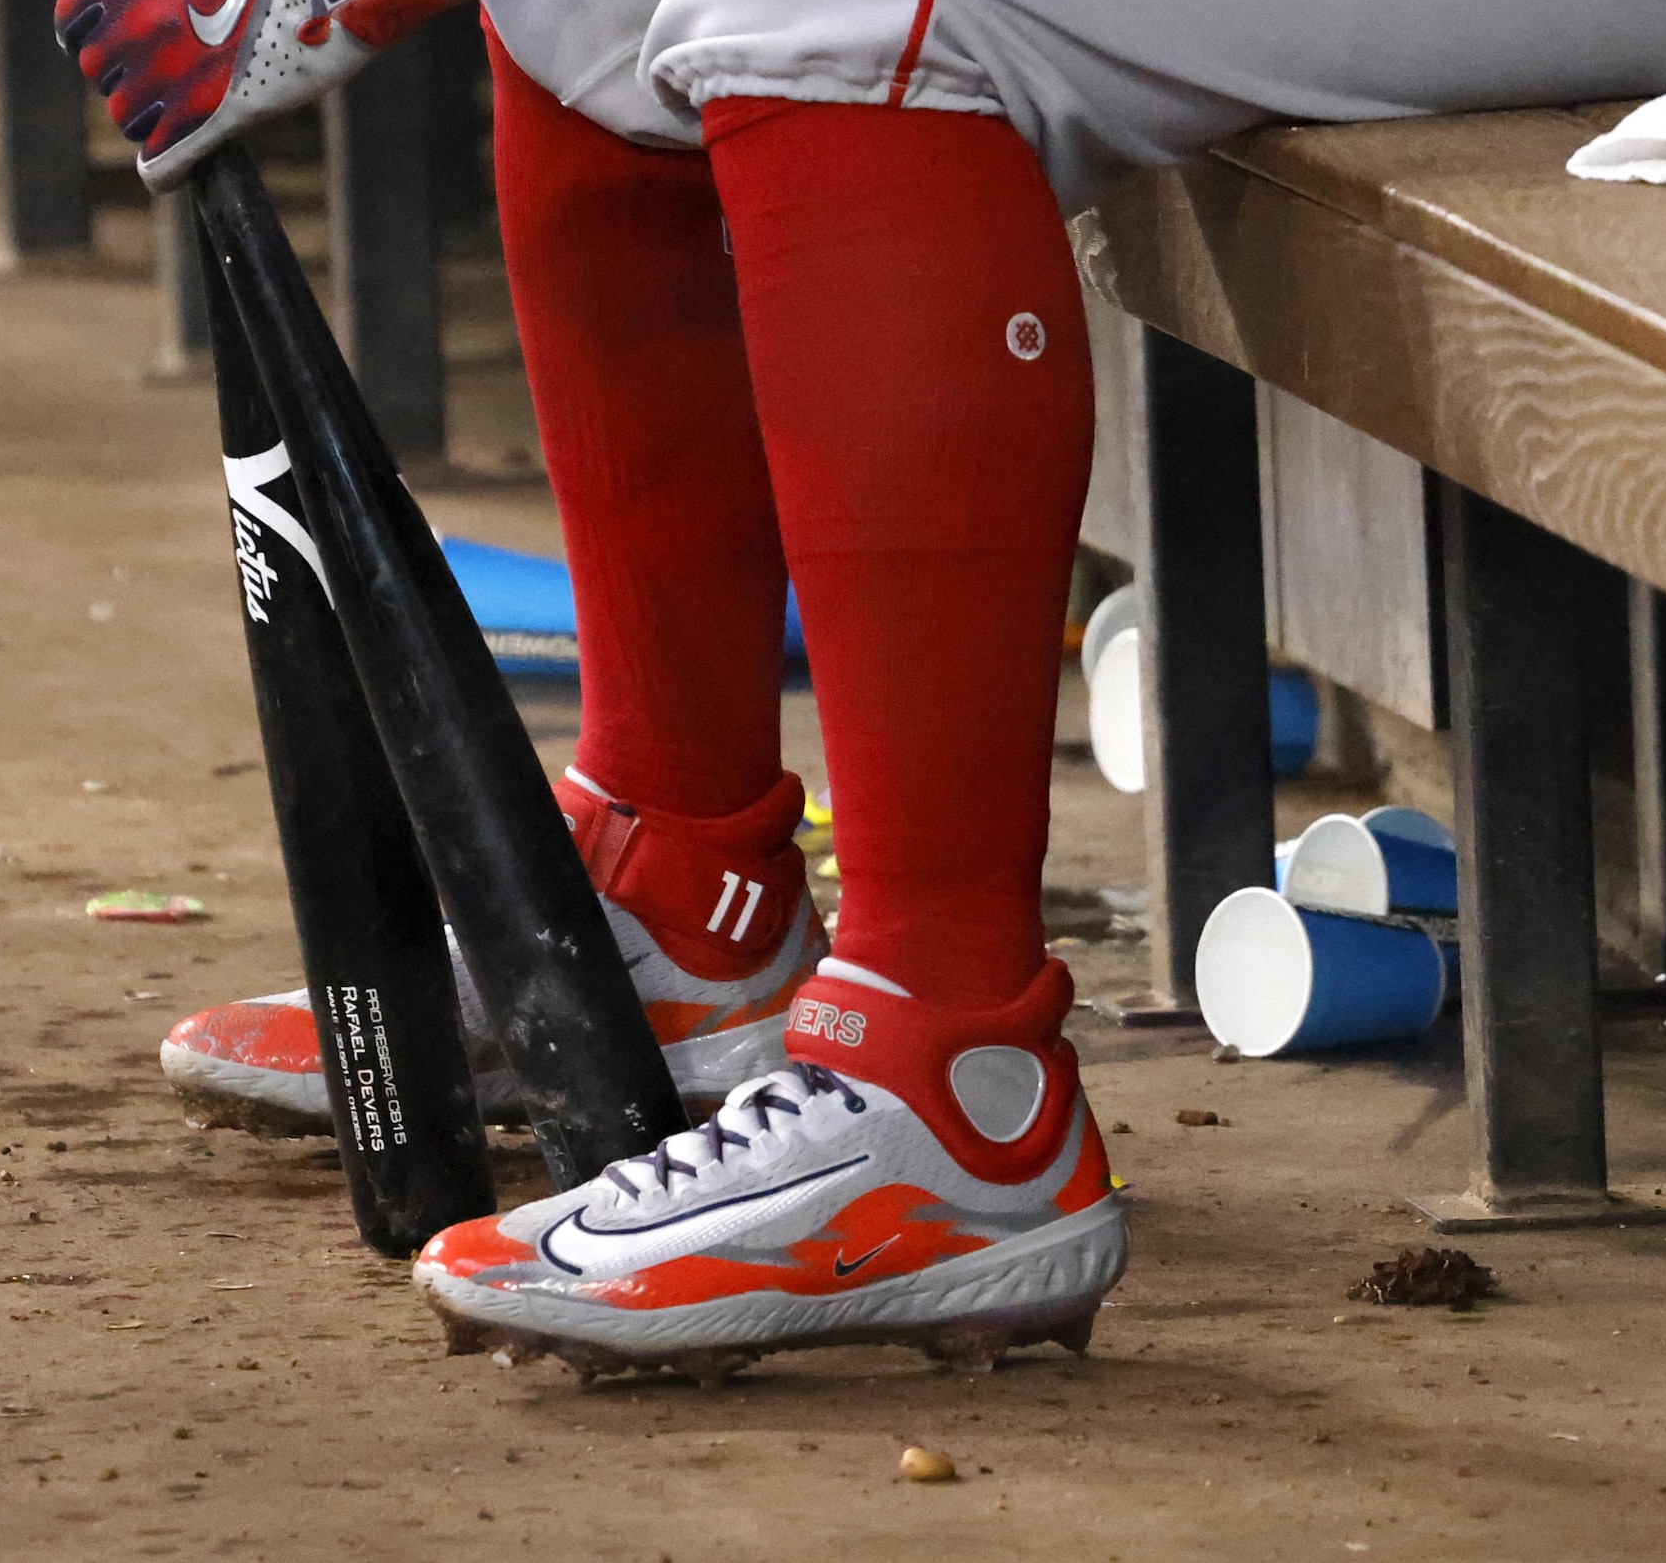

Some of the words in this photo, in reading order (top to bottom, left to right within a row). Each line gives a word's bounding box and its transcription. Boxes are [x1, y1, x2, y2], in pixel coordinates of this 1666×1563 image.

[705, 869, 764, 943] 11
[365, 988, 383, 1023] PRO
[373, 1025, 399, 1098] RESERVE
[388, 1099, 408, 1145] CB15
